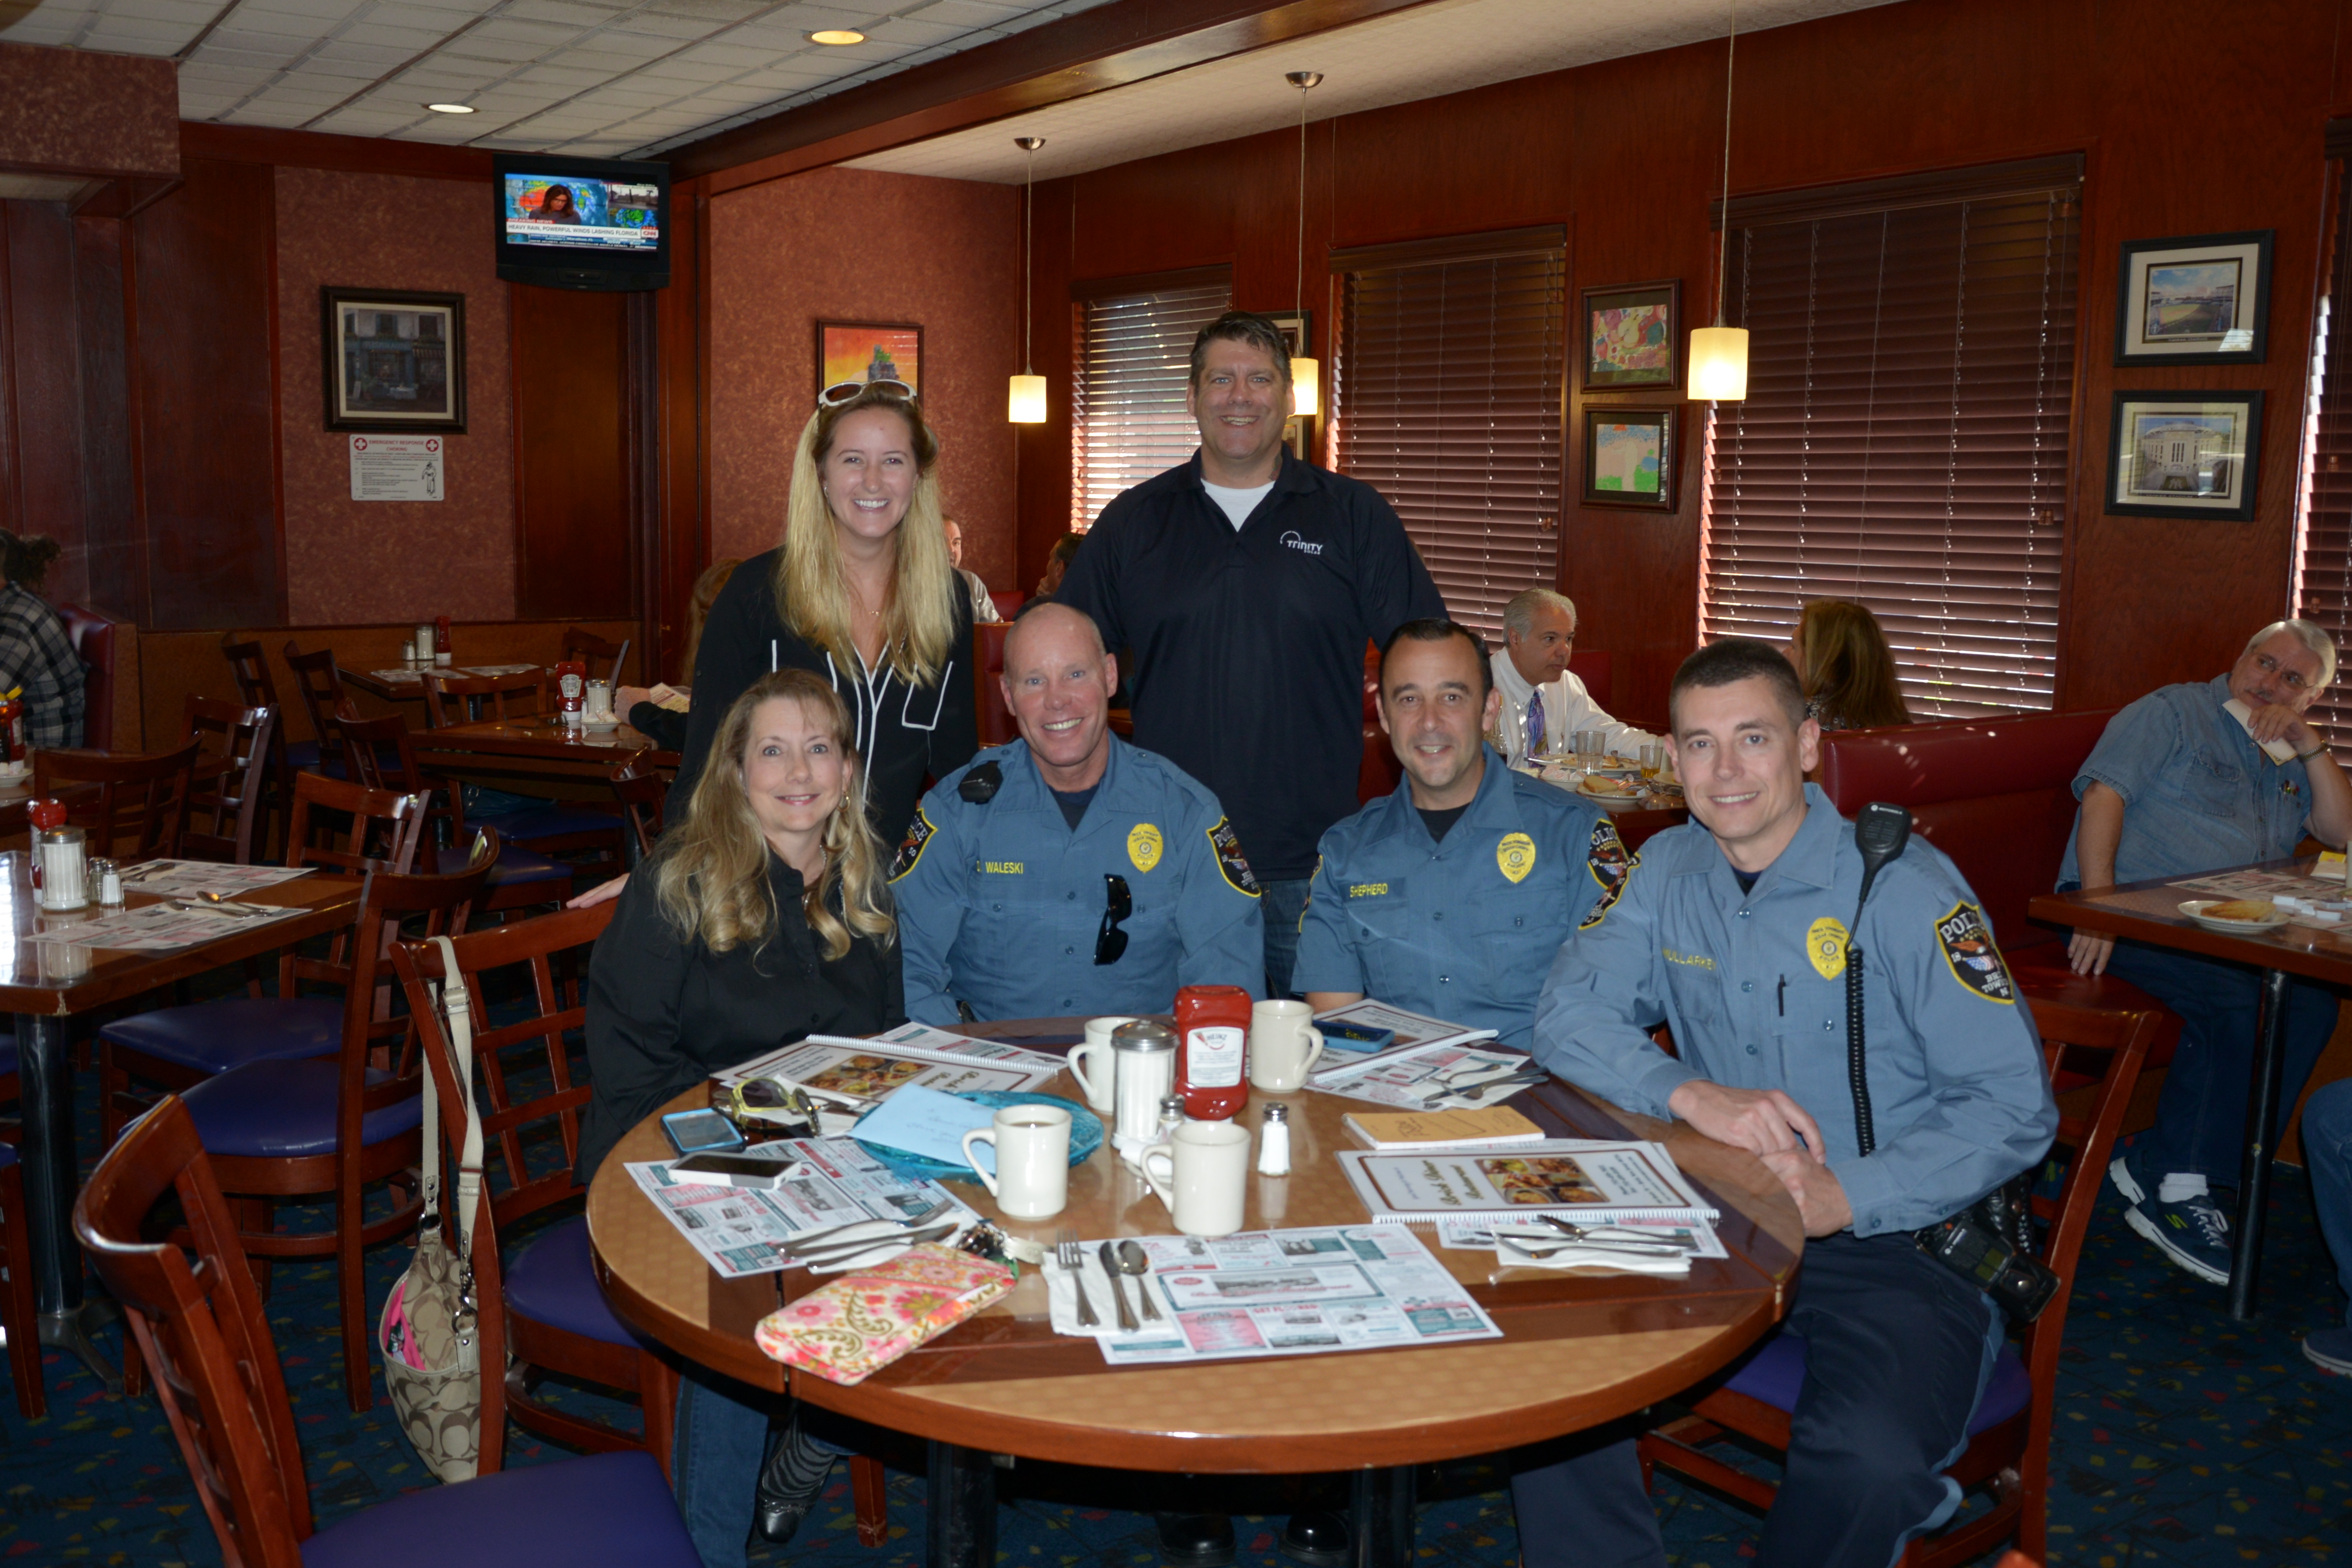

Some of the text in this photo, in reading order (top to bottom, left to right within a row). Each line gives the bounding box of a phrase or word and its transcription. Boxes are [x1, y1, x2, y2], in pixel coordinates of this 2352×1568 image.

[908, 847, 917, 857] 50
[985, 861, 1024, 874] WALESKI
[1350, 883, 1388, 898] SHEPHERD
[1951, 952, 1962, 962] 18
